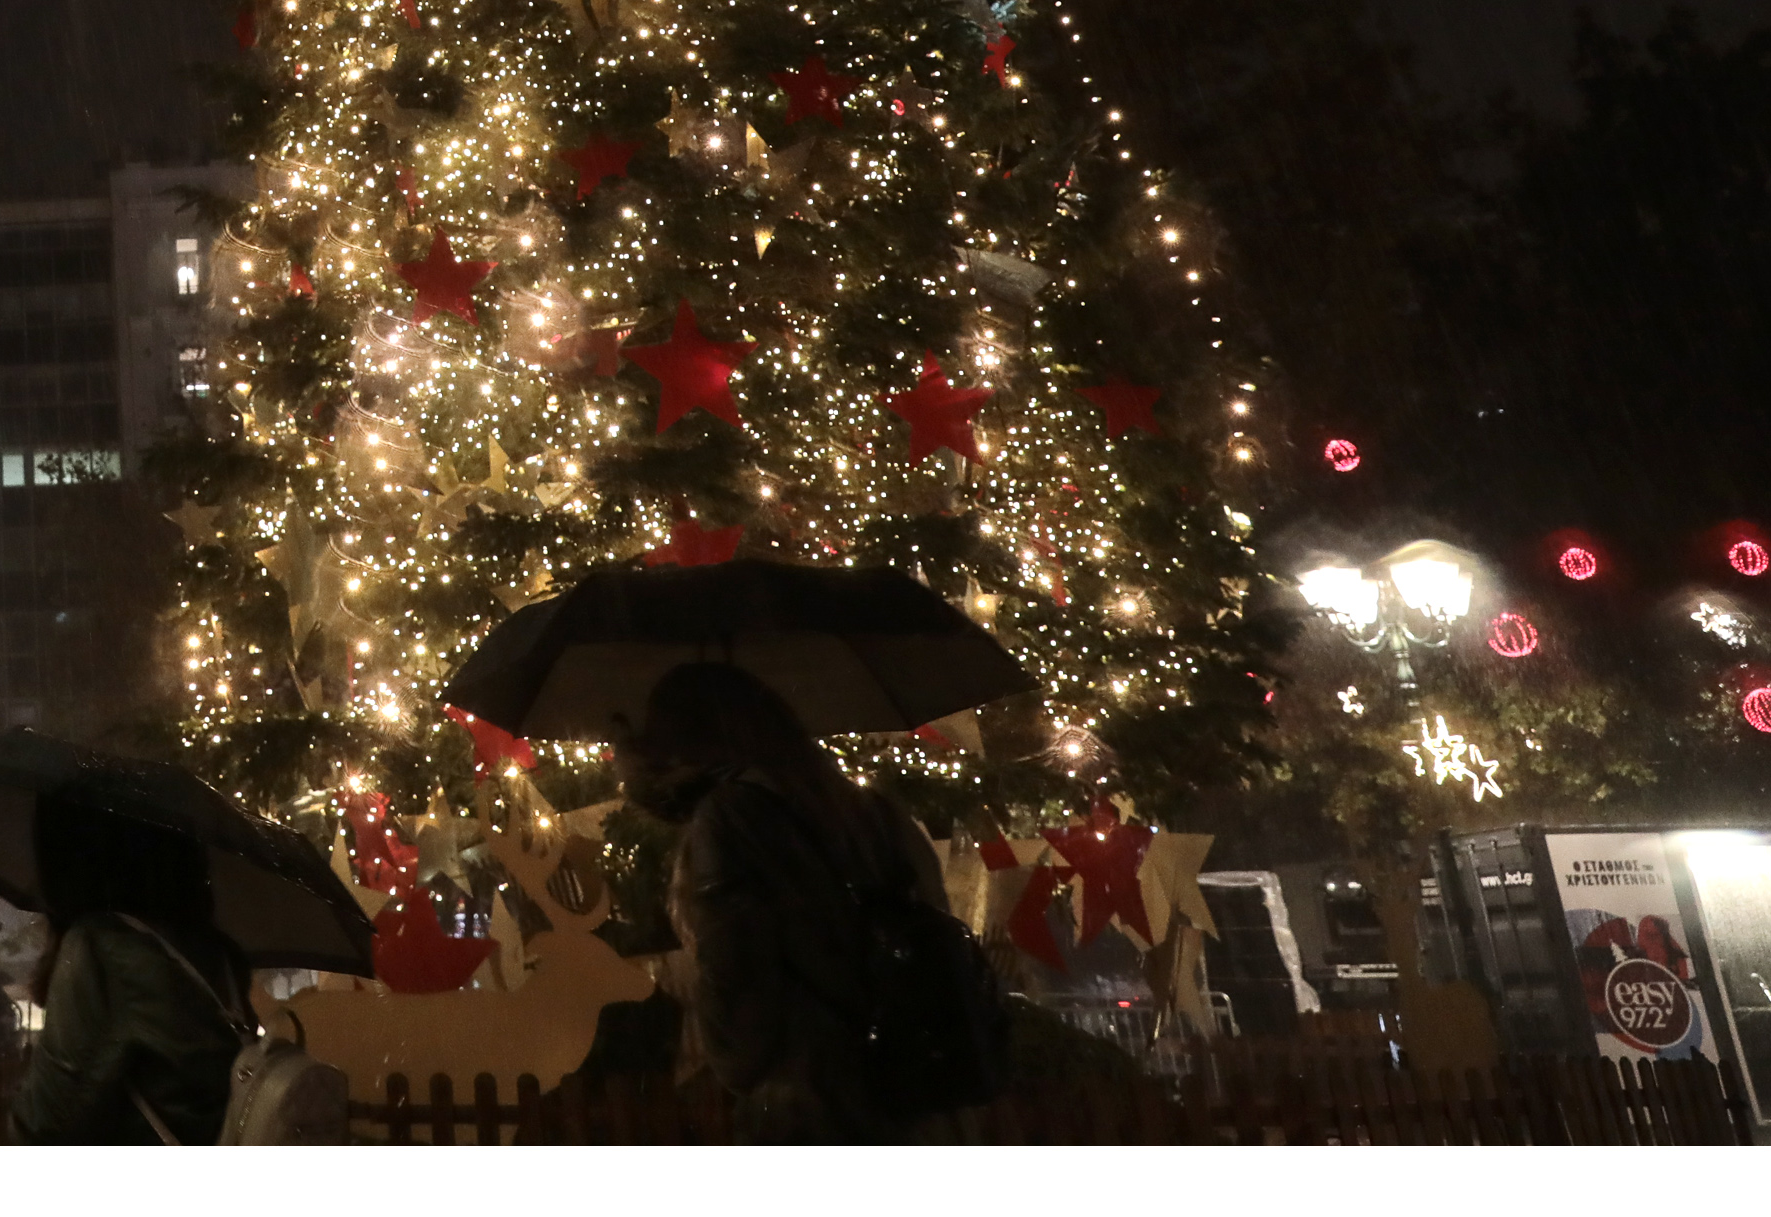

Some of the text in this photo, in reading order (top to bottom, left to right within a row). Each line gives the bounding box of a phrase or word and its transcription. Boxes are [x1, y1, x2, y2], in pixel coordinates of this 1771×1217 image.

[1584, 859, 1640, 872] ΣΤΑΘΜΟΣ
[1614, 981, 1676, 1015] easy
[1619, 1006, 1667, 1028] 97.2
